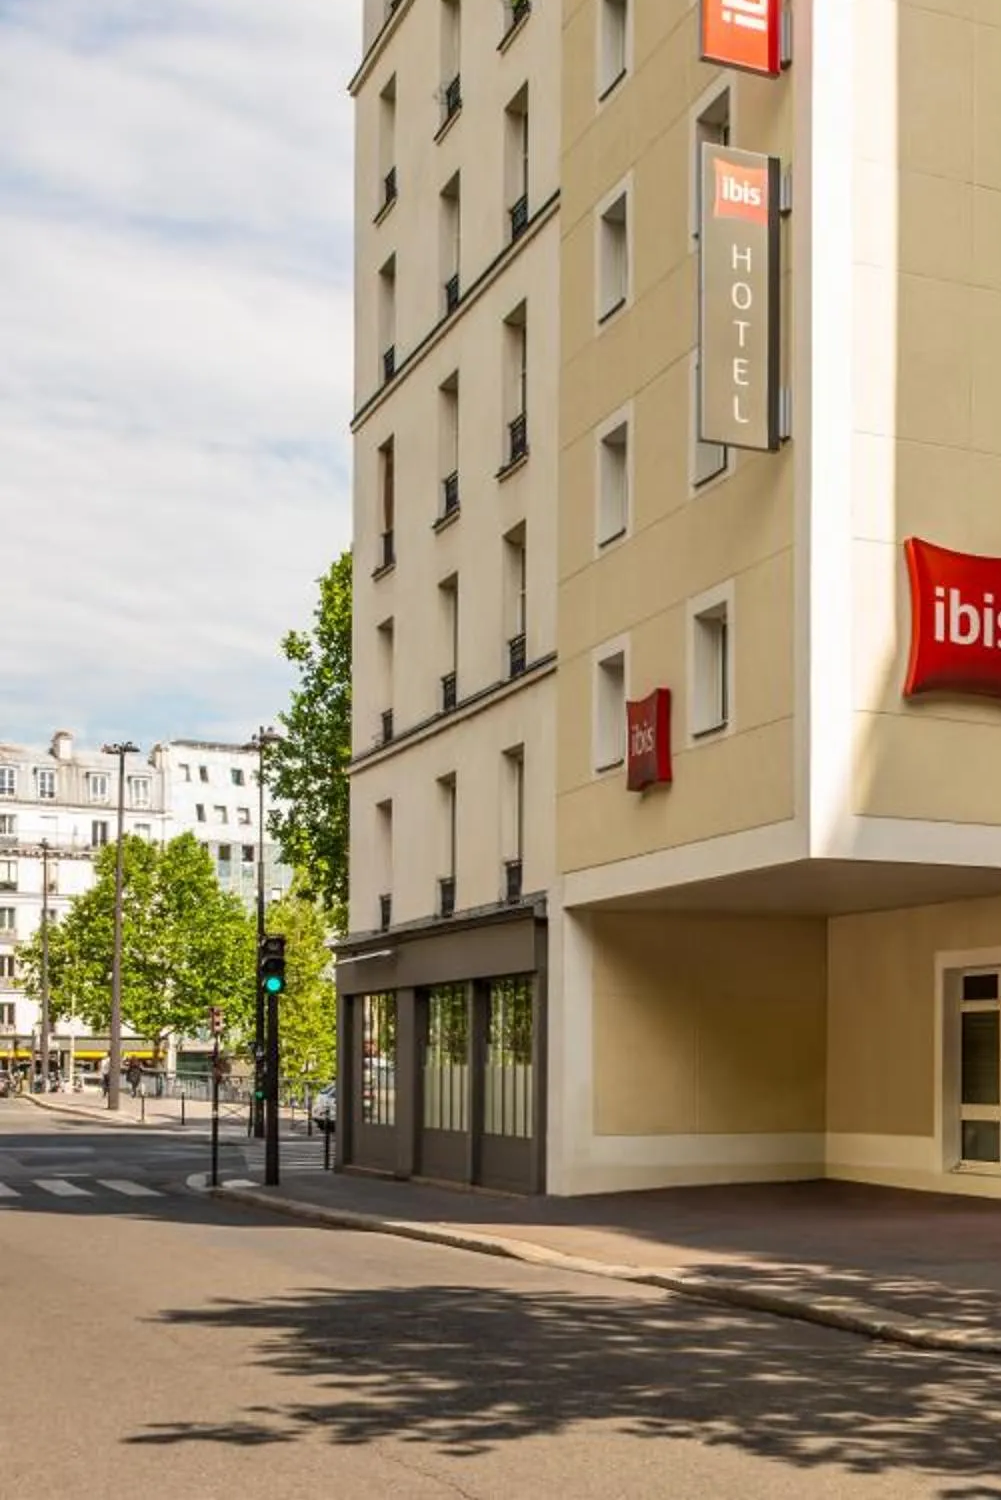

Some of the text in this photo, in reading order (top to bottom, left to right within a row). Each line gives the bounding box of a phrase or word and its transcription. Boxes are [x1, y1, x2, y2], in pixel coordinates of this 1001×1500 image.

[722, 176, 761, 205] ibis
[731, 243, 752, 424] HOTEL
[631, 720, 654, 757] ibis
